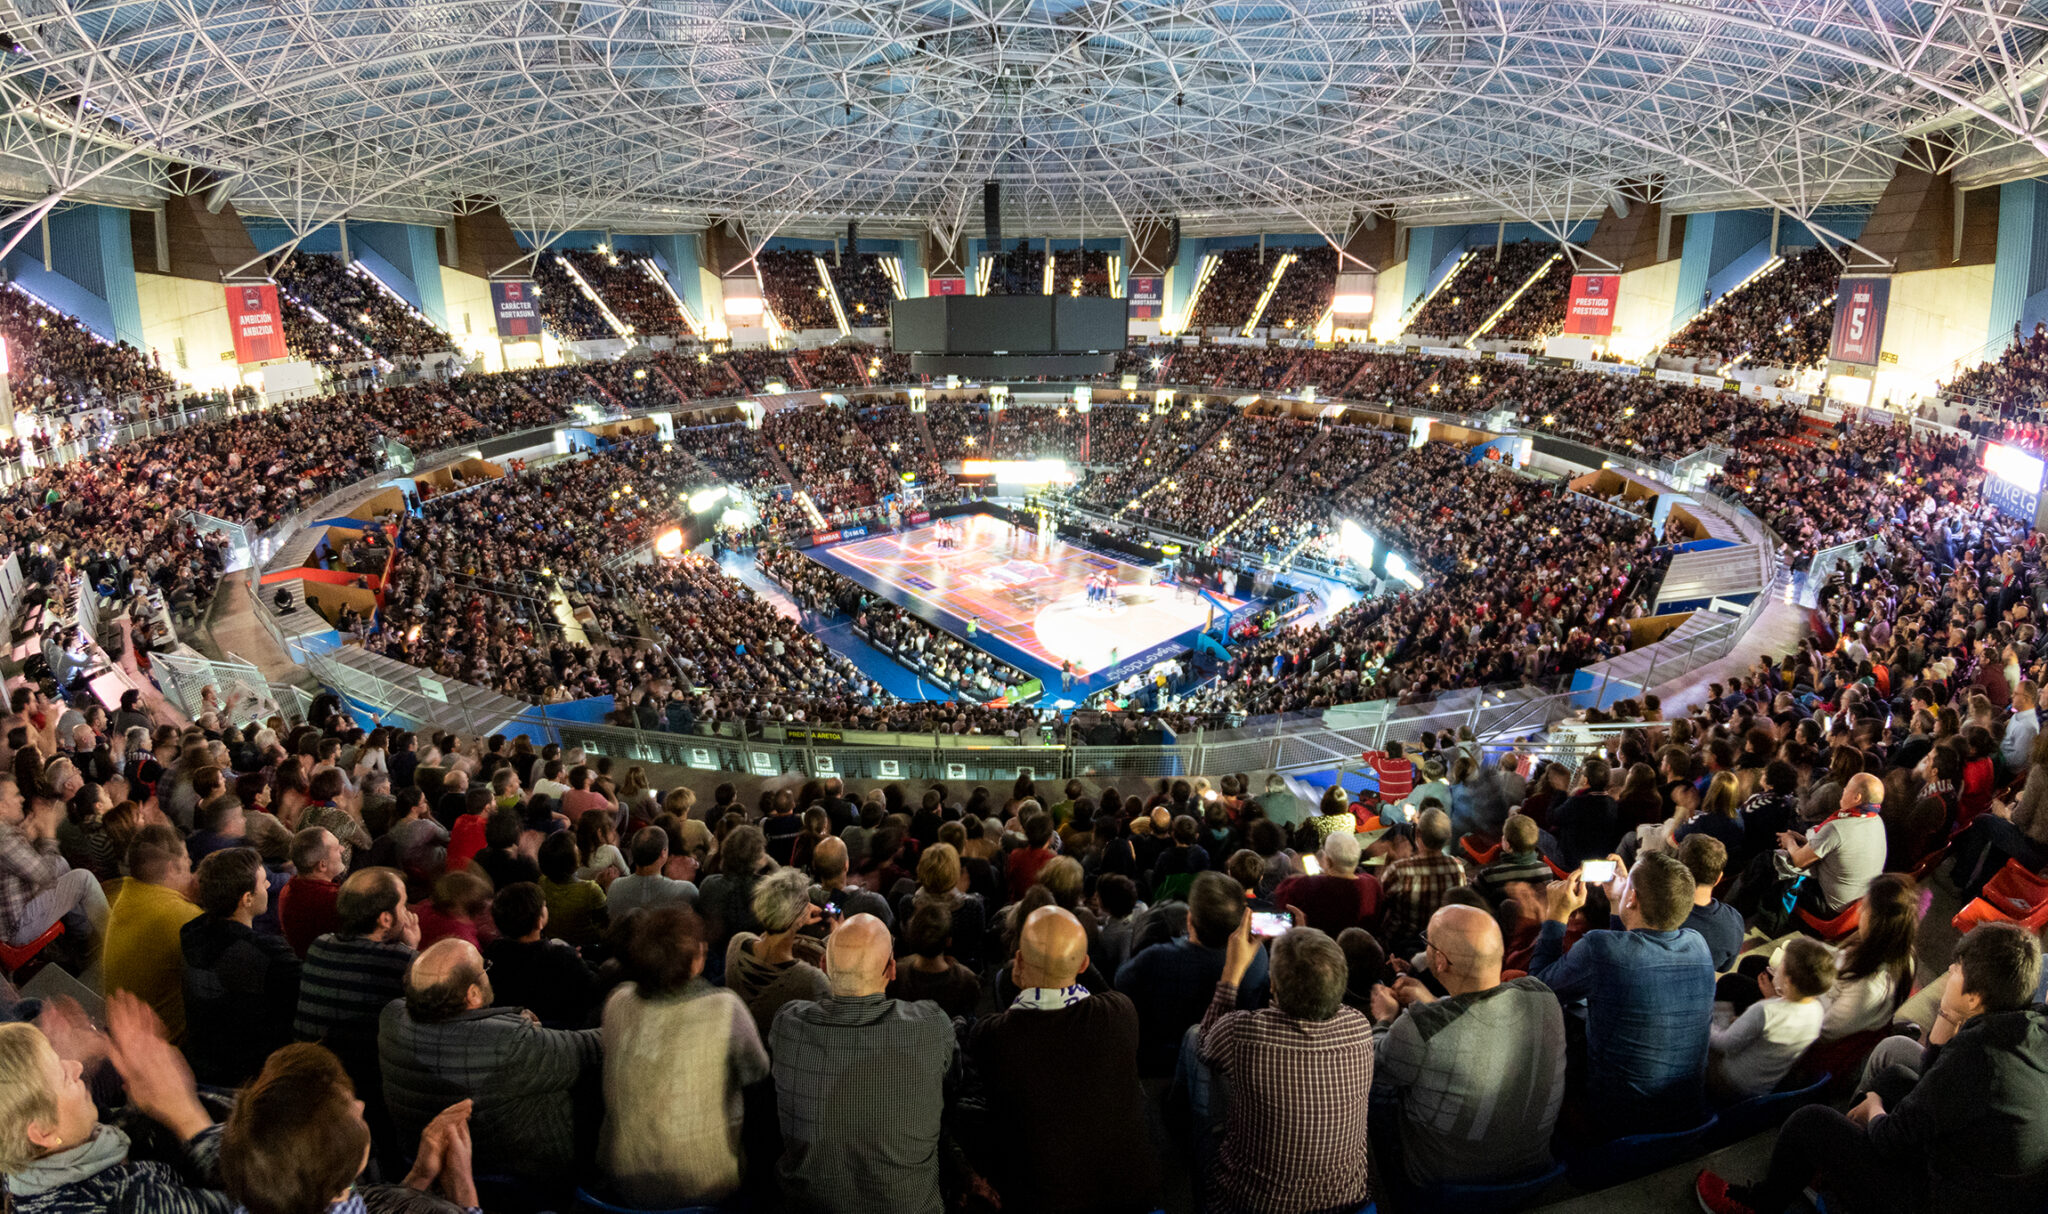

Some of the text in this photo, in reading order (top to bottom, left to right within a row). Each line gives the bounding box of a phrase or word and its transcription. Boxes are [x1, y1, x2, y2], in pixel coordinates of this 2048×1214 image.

[500, 301, 532, 310] CARÁCTER
[1575, 297, 1609, 307] PRESTIGIO
[500, 310, 535, 318] NORTASUNA
[1572, 306, 1609, 316] PRESTIGIOA
[239, 311, 272, 325] AMBICIÓN
[1850, 308, 1866, 340] 5
[820, 533, 840, 541] AMBAR
[817, 732, 841, 740] ARETOA
